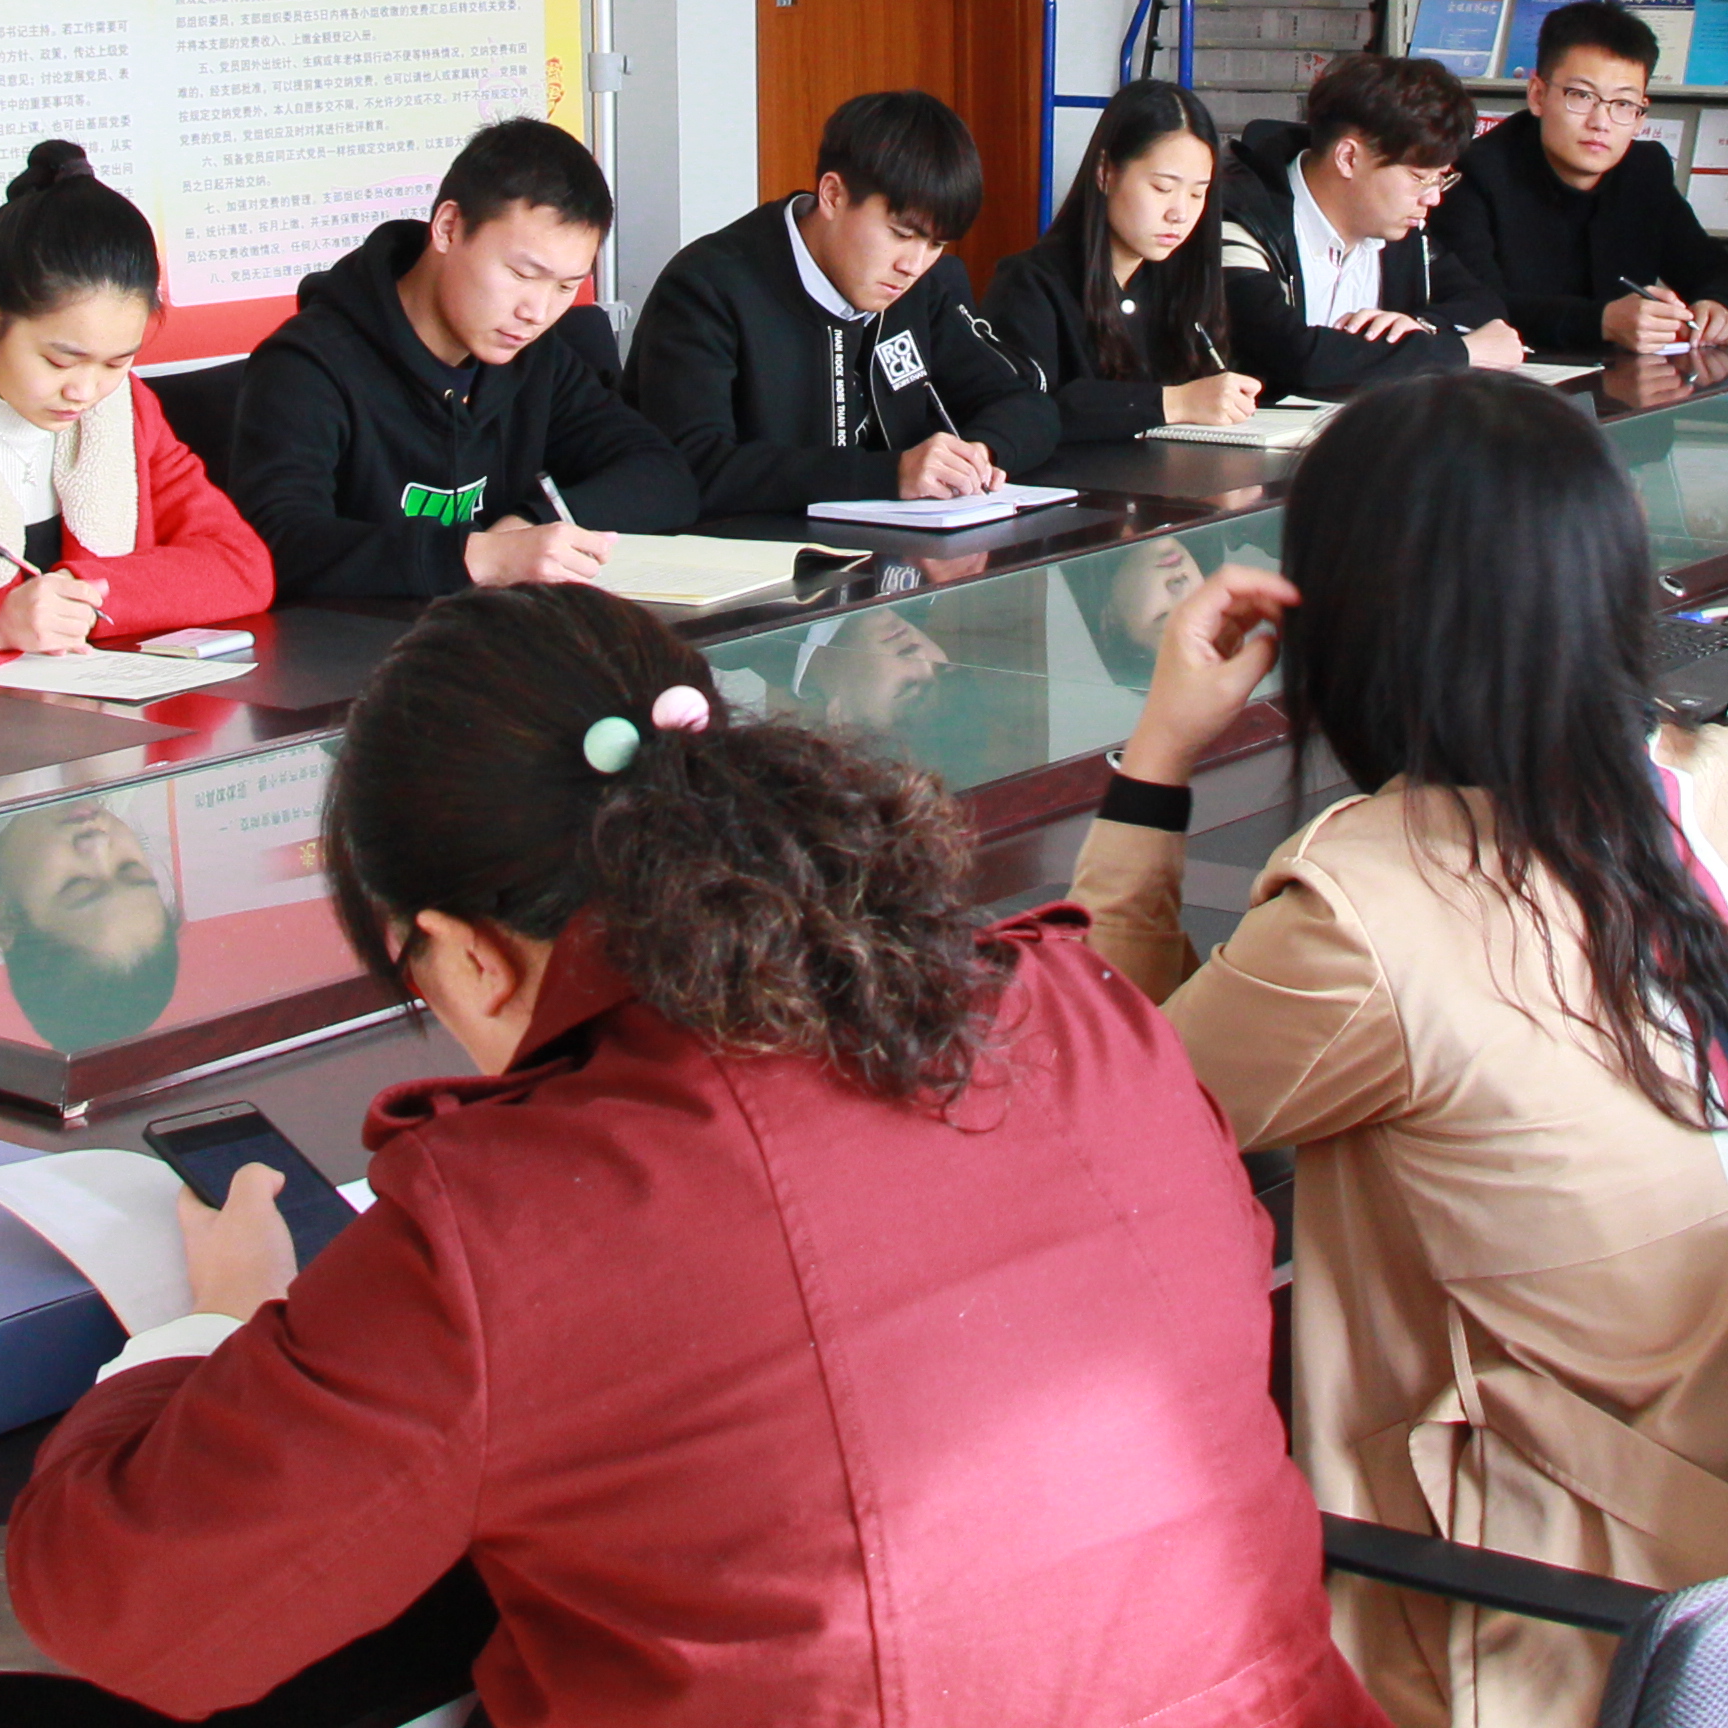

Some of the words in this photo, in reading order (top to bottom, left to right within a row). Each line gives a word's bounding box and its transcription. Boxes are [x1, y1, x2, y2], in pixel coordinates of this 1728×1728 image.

[835, 354, 844, 377] ROCK
[837, 405, 846, 427] THAN
[837, 429, 847, 447] ROC
